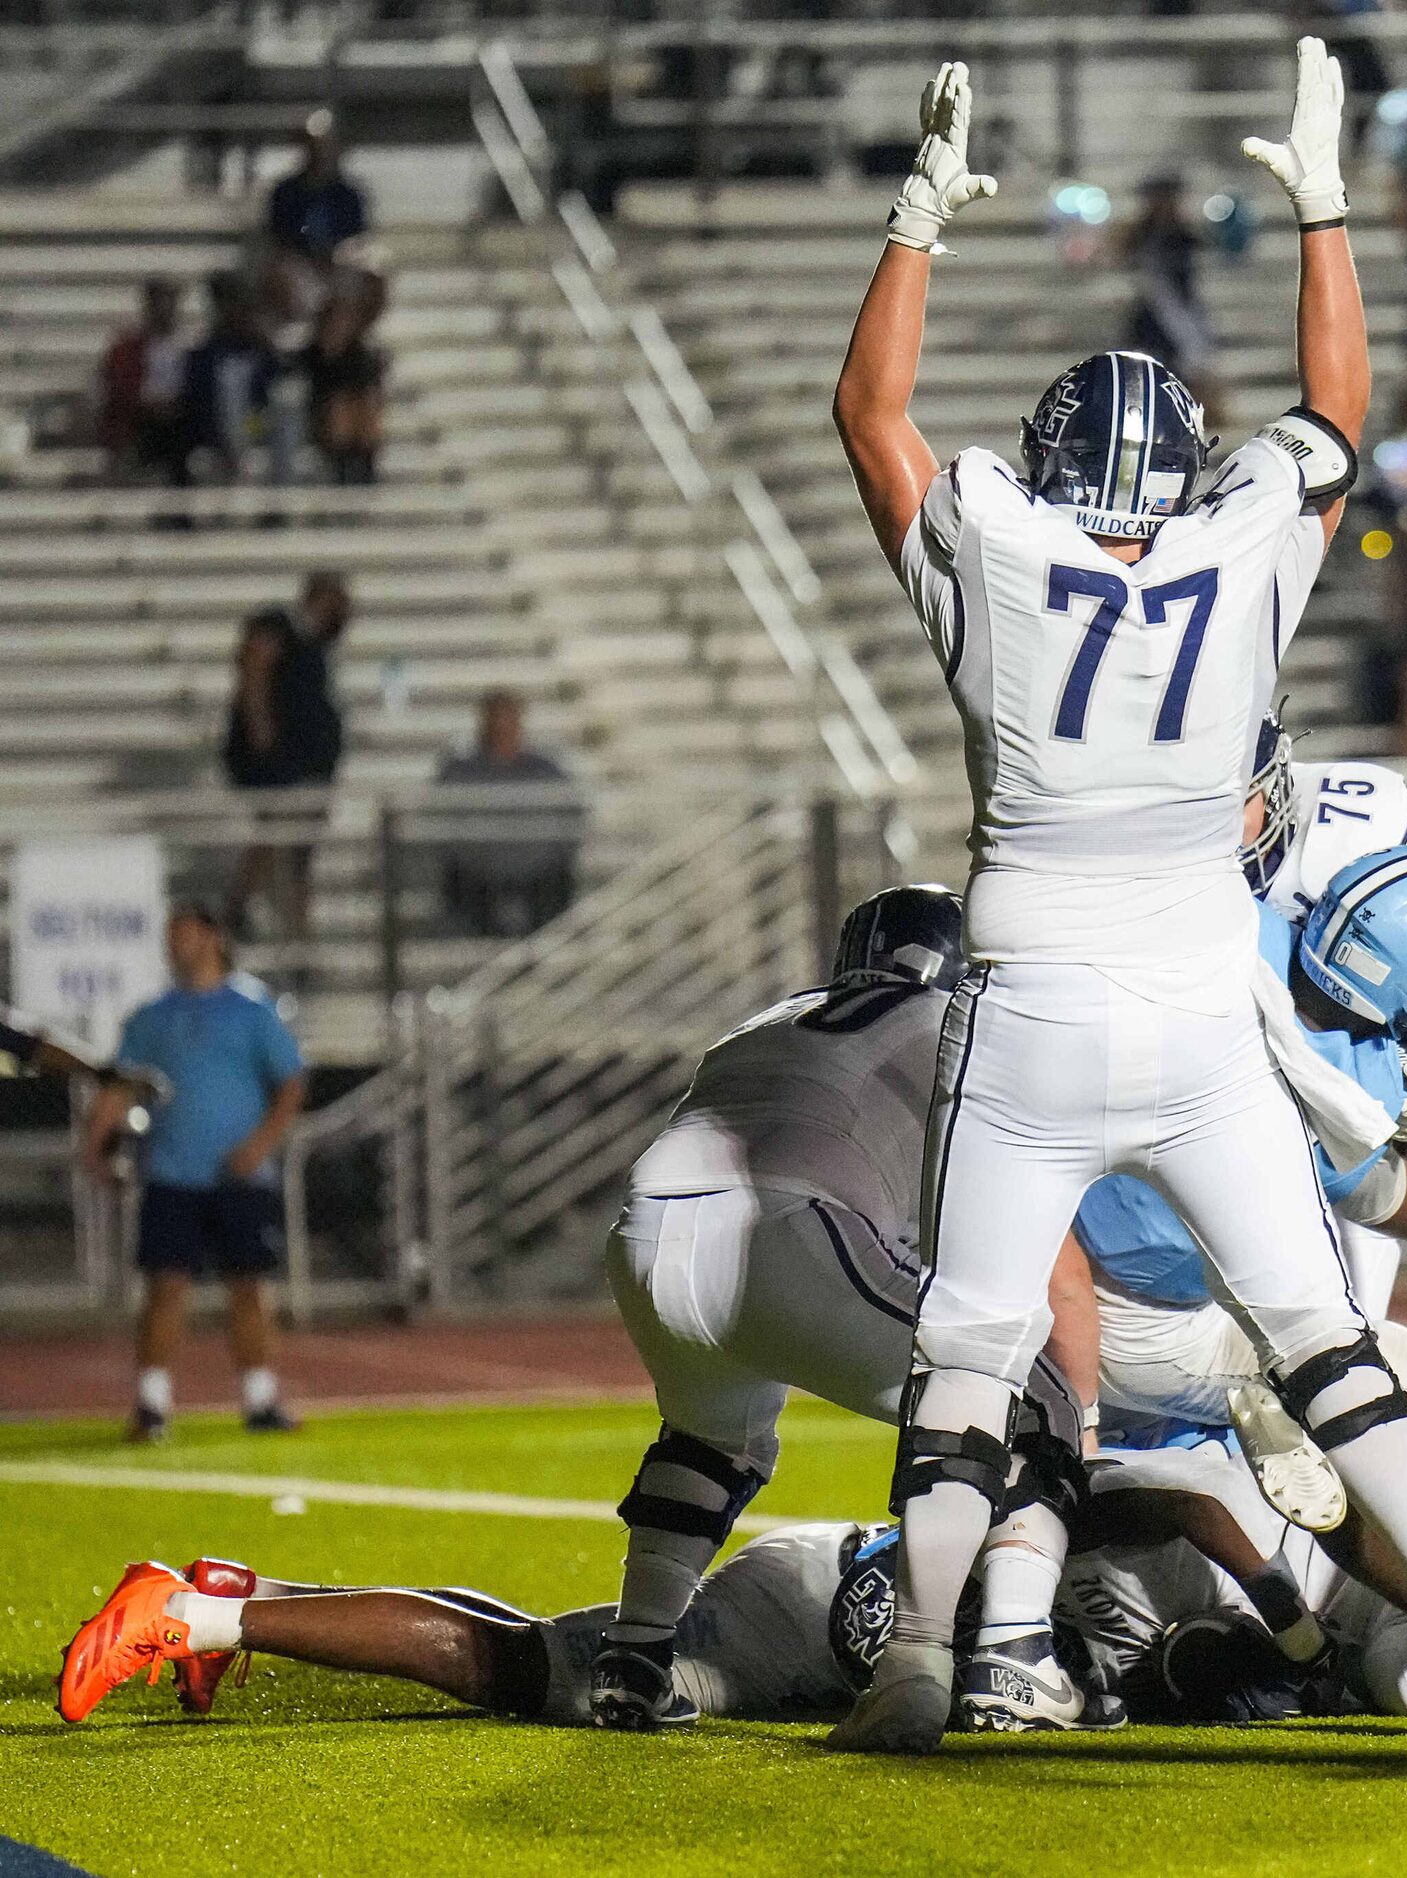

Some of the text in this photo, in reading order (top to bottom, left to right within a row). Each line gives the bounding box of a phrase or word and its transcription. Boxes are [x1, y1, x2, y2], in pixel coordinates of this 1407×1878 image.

[1075, 511, 1164, 537] WILDCATS
[1041, 559, 1223, 746] 77
[1317, 776, 1376, 825] 75
